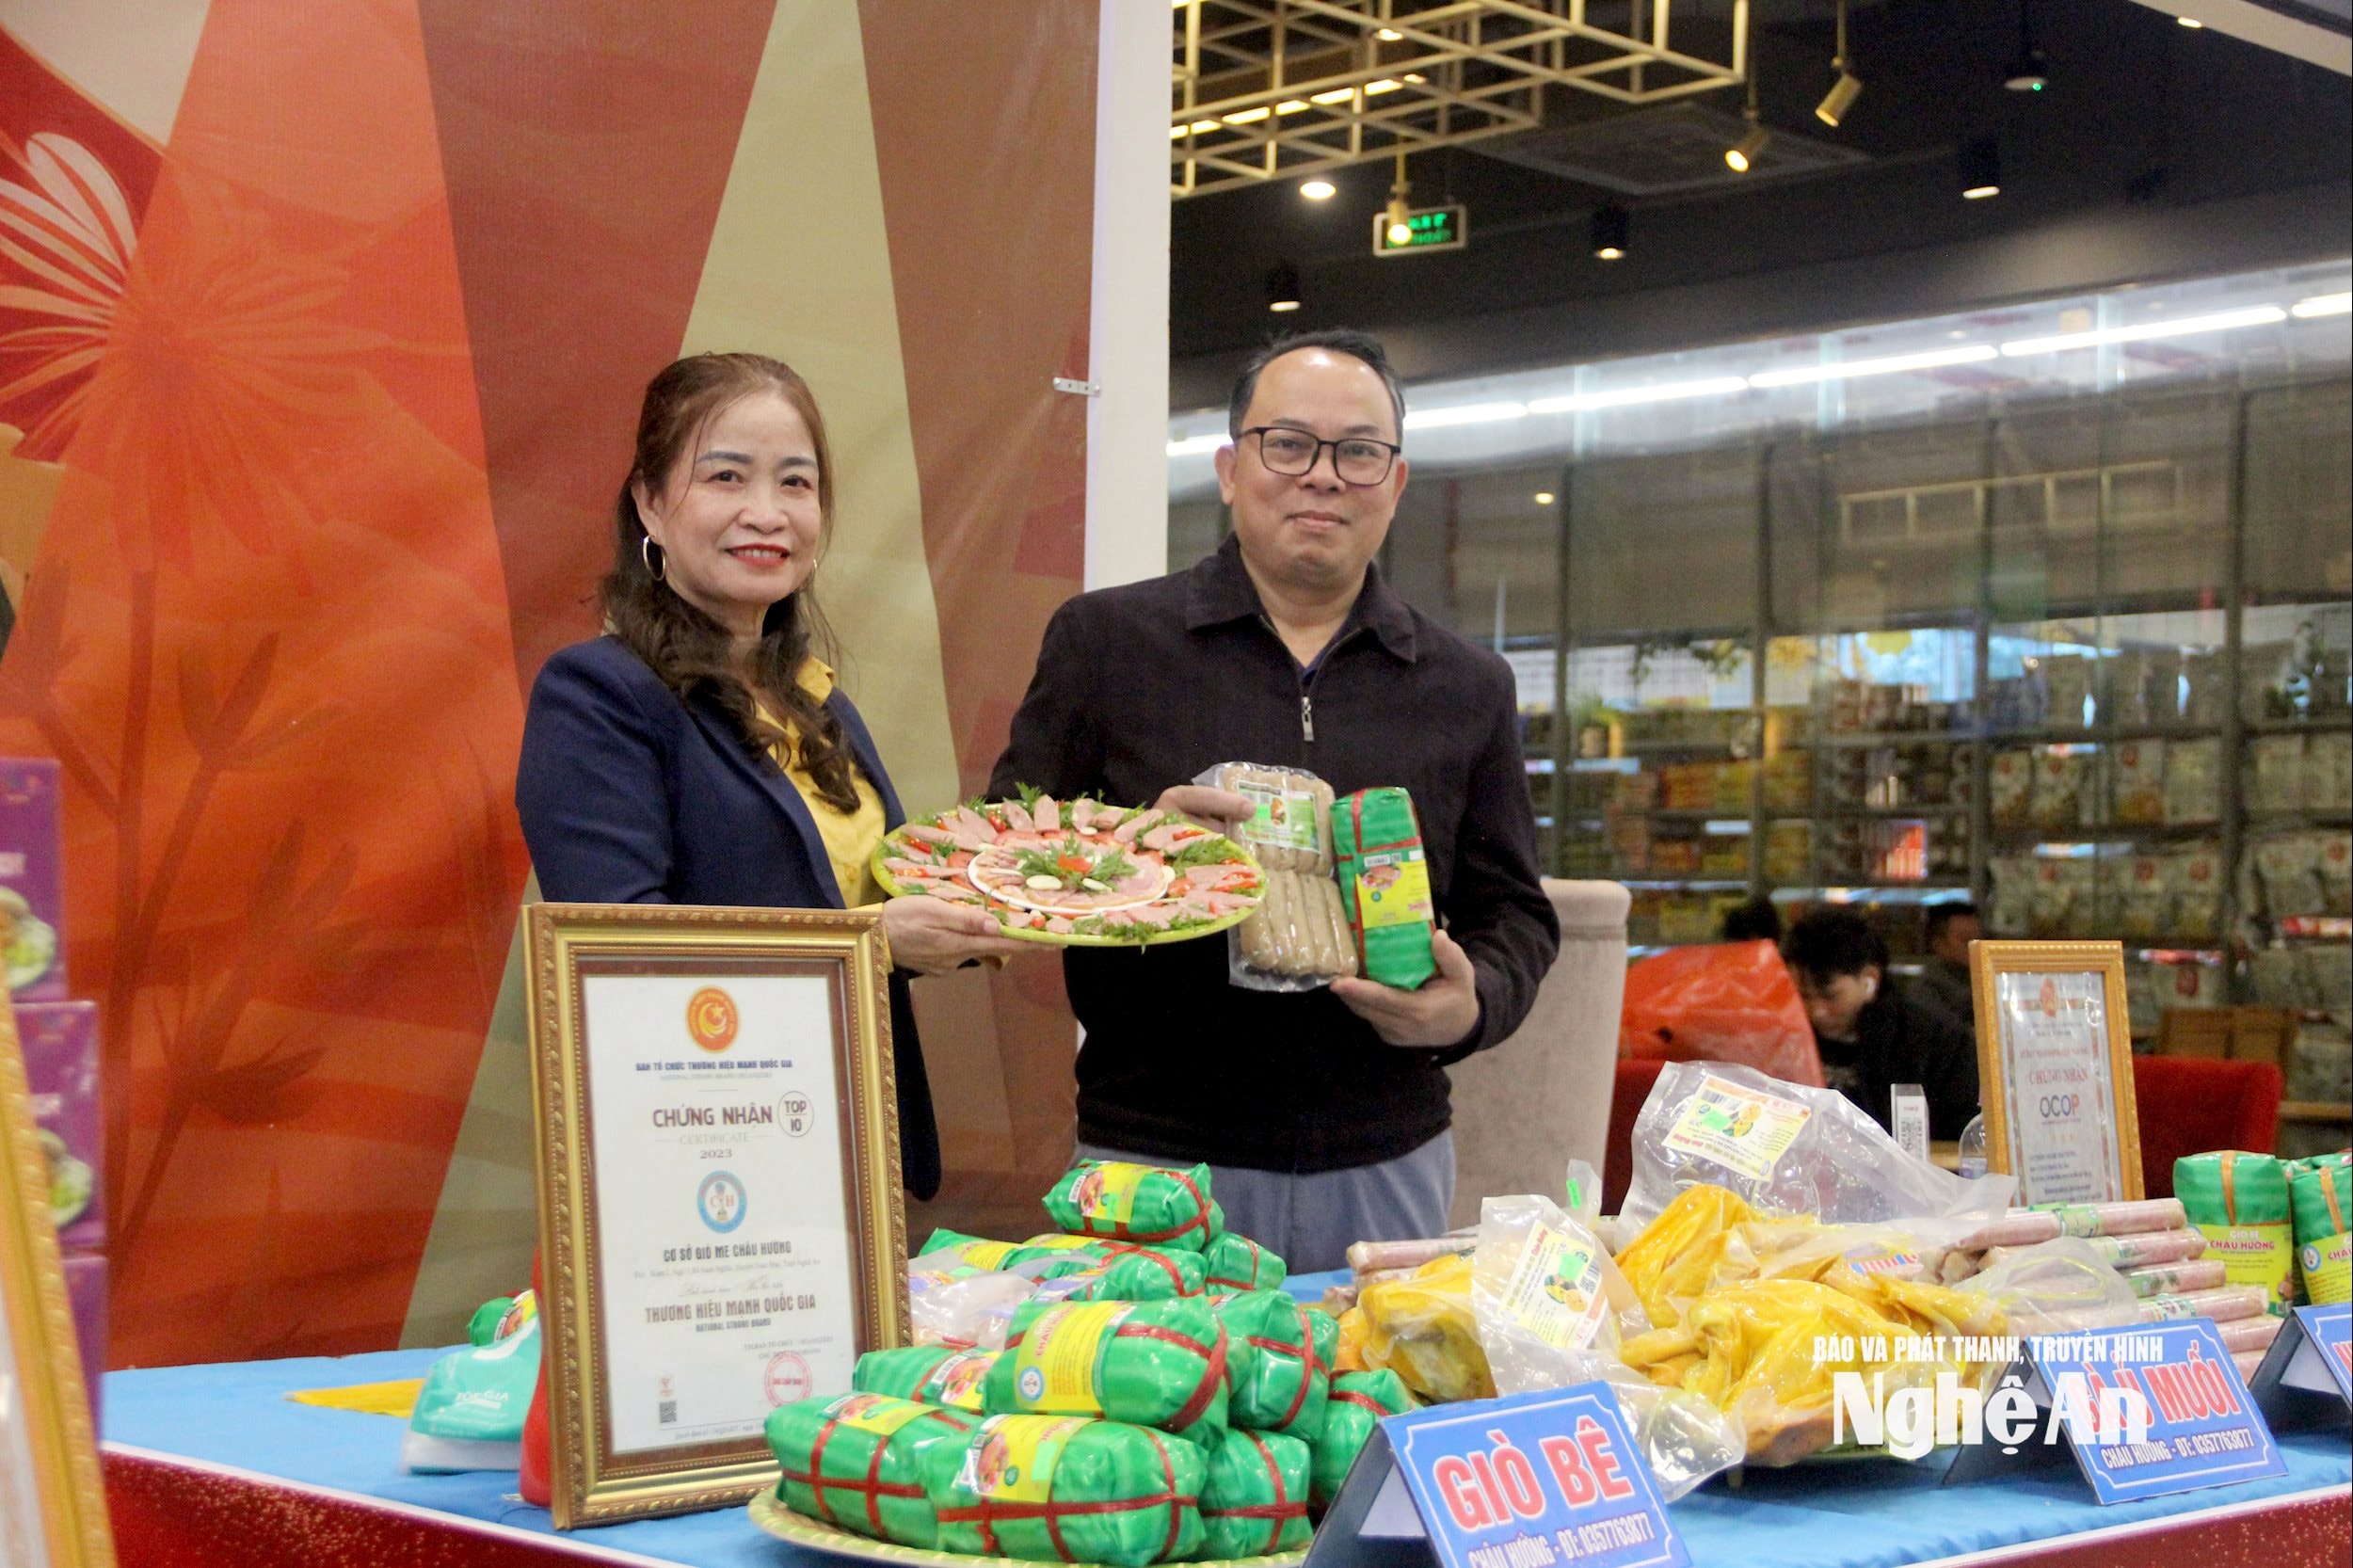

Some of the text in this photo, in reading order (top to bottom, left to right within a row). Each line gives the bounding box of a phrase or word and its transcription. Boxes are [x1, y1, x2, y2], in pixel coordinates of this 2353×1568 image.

[652, 1101, 774, 1128] CHỨNG NHẬN
[784, 1099, 808, 1114] TOP
[2040, 1093, 2080, 1118] OCOP
[679, 1131, 751, 1145] CERTIFICATE
[790, 1117, 802, 1132] 10
[699, 1148, 733, 1160] 2023
[645, 1291, 817, 1323] THƯƠNG HIỆU MẠNH QUỐC GIA
[2140, 1339, 2242, 1425] MUỐI
[2192, 1428, 2255, 1456] 0357763877
[1432, 1415, 1635, 1533] GIÒ BÊ
[1577, 1512, 1656, 1553] 0357763877
